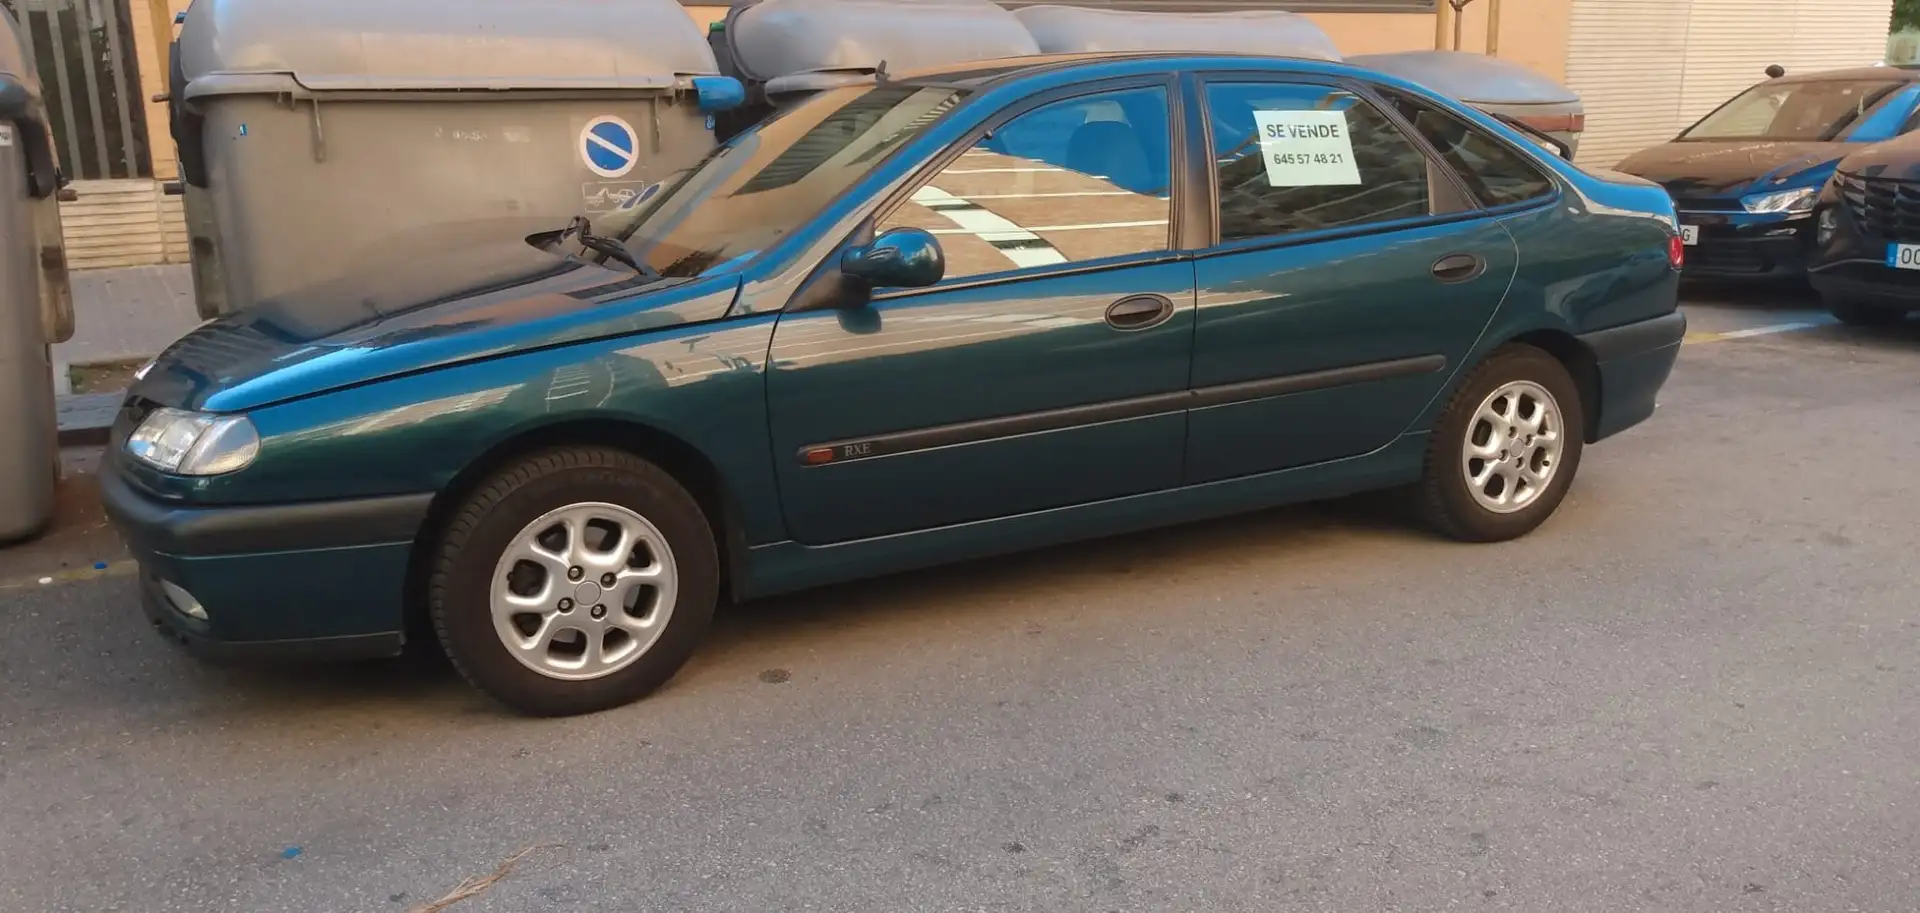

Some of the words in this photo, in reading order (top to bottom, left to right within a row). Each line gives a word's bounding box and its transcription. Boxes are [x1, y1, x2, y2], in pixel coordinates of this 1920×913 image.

[1266, 124, 1286, 138] SE
[1288, 124, 1341, 138] VENDE
[1273, 153, 1295, 165] 645
[1297, 153, 1310, 165] 57
[1314, 153, 1328, 164] 48
[1329, 153, 1343, 164] 21
[844, 442, 871, 457] RXE
